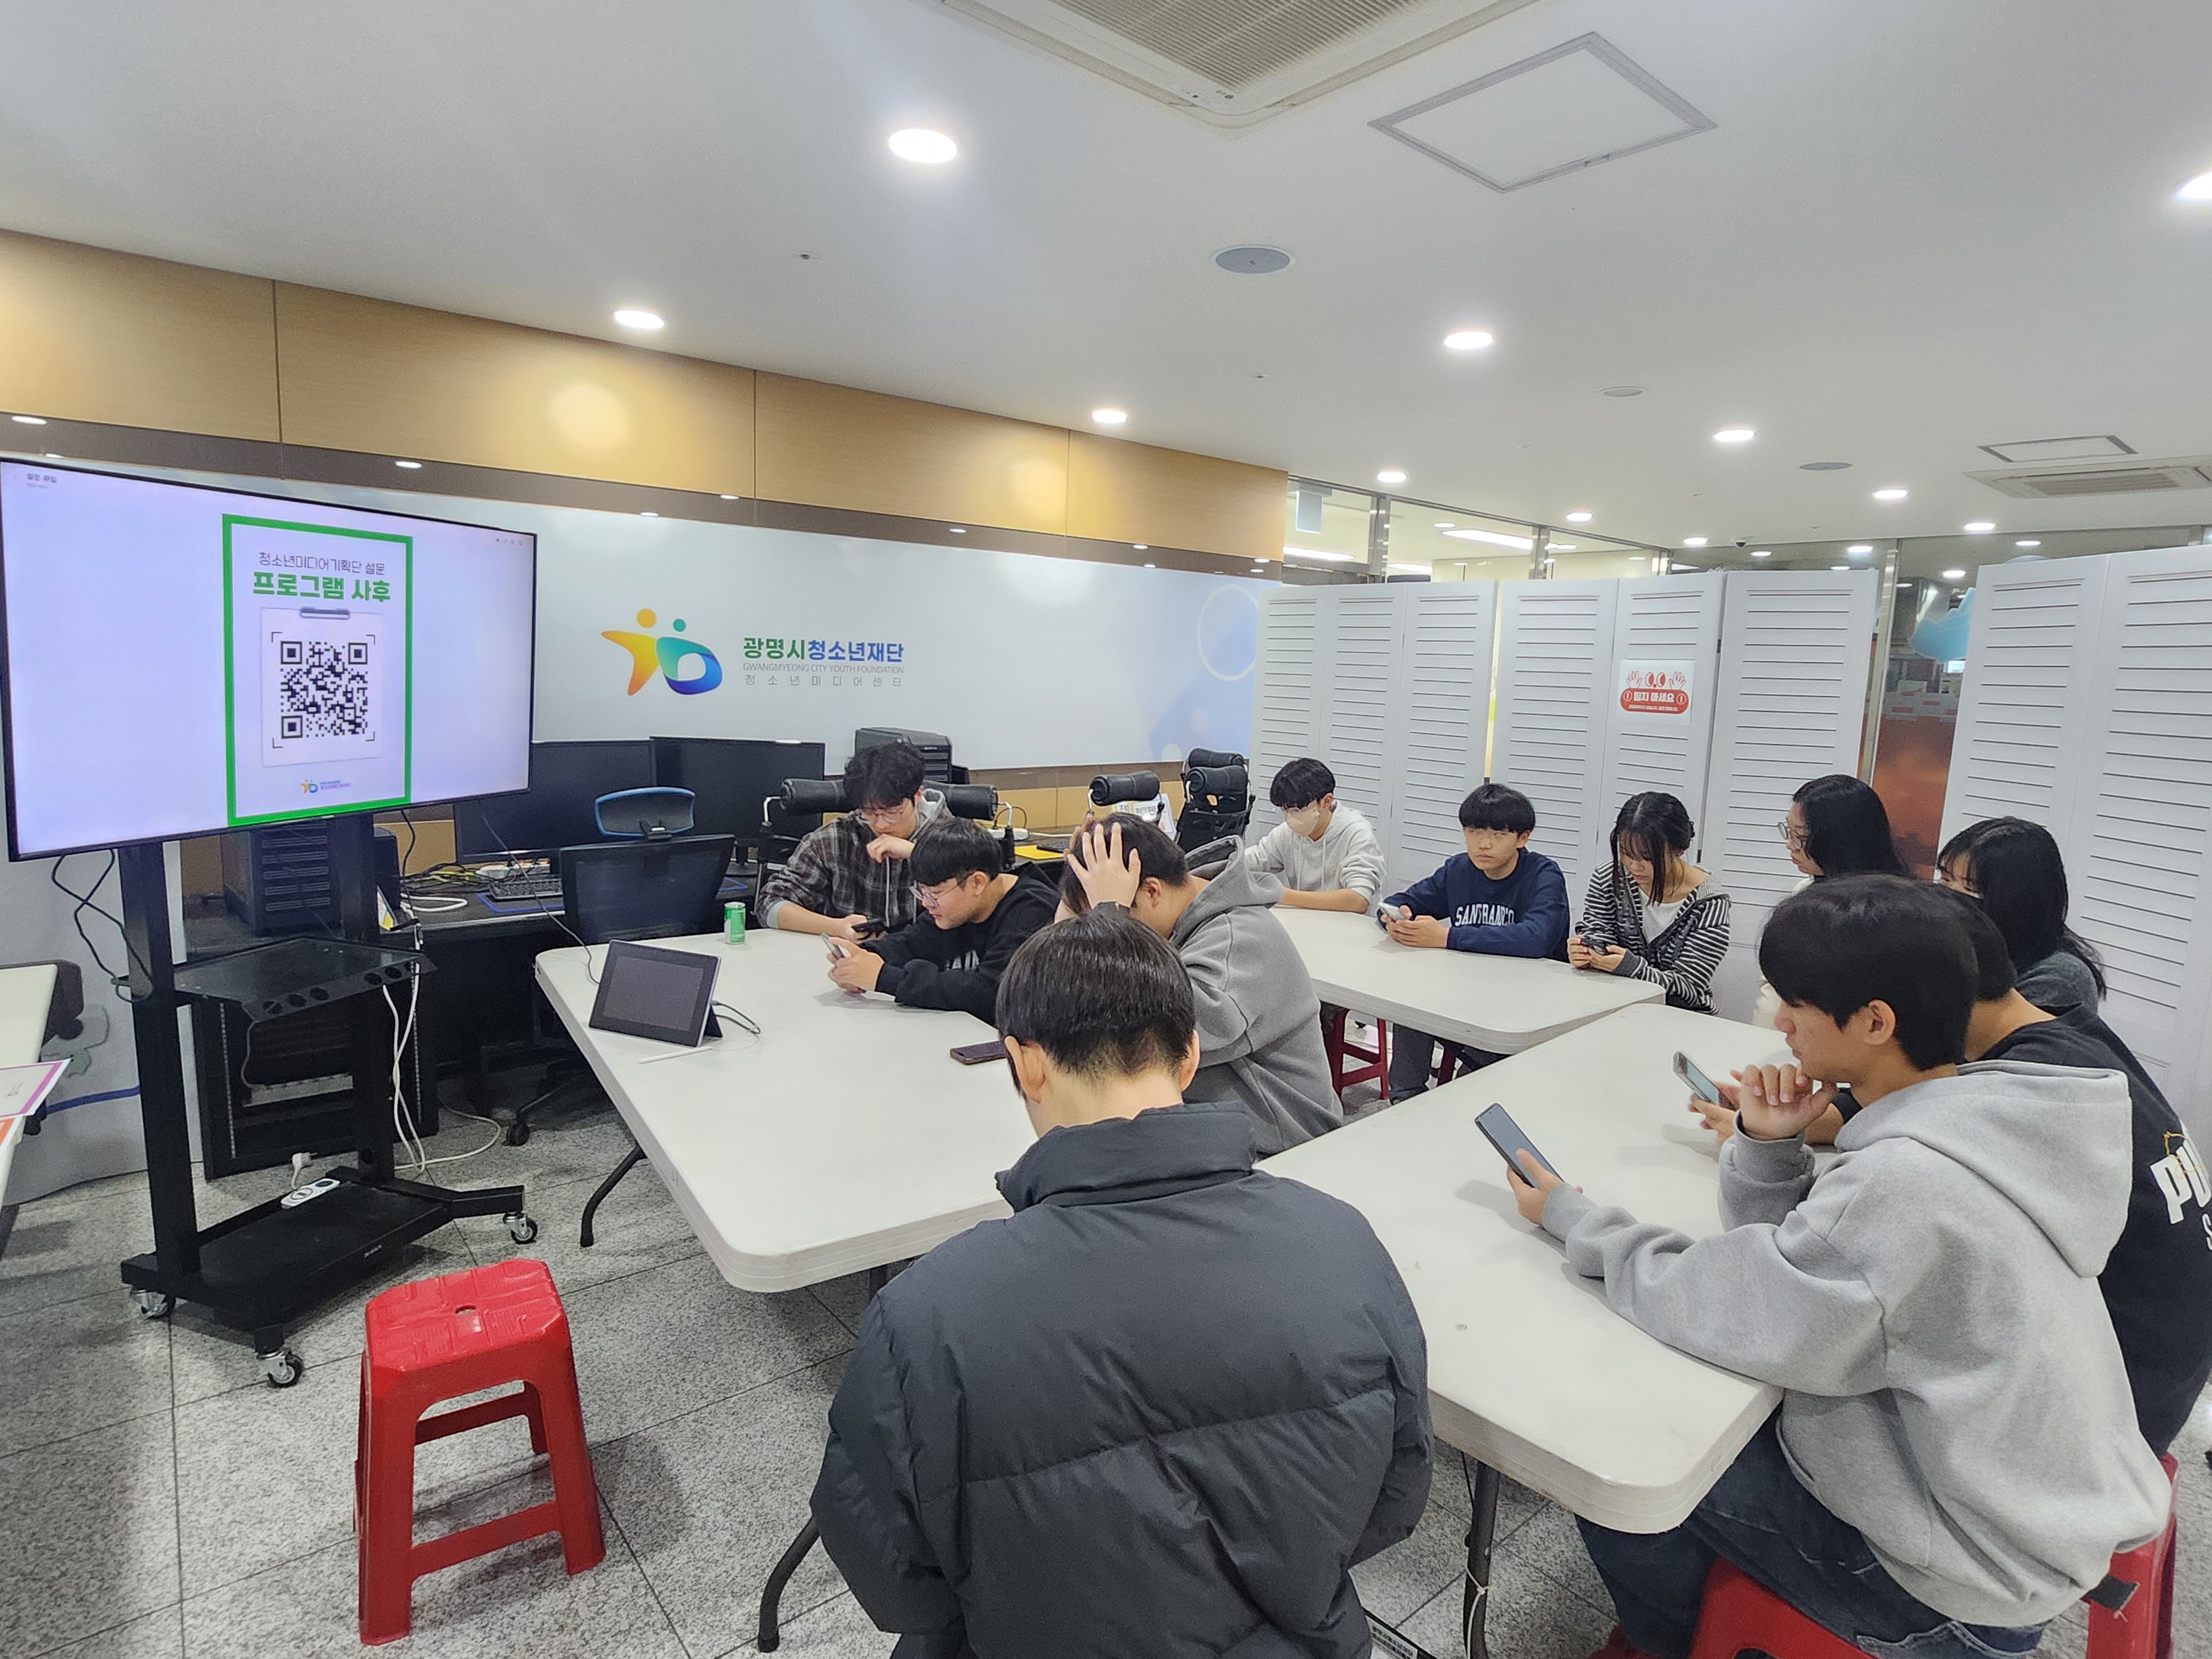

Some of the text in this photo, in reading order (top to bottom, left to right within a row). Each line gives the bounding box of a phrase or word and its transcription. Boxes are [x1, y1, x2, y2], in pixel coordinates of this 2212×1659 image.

[259, 552, 385, 576] 청소년미디어기획단 설문
[253, 571, 390, 602] 프로그램 사후
[743, 637, 904, 662] 광명시청소년재단
[743, 663, 809, 672] GWANGMYEONG
[830, 665, 855, 673] YOUTH
